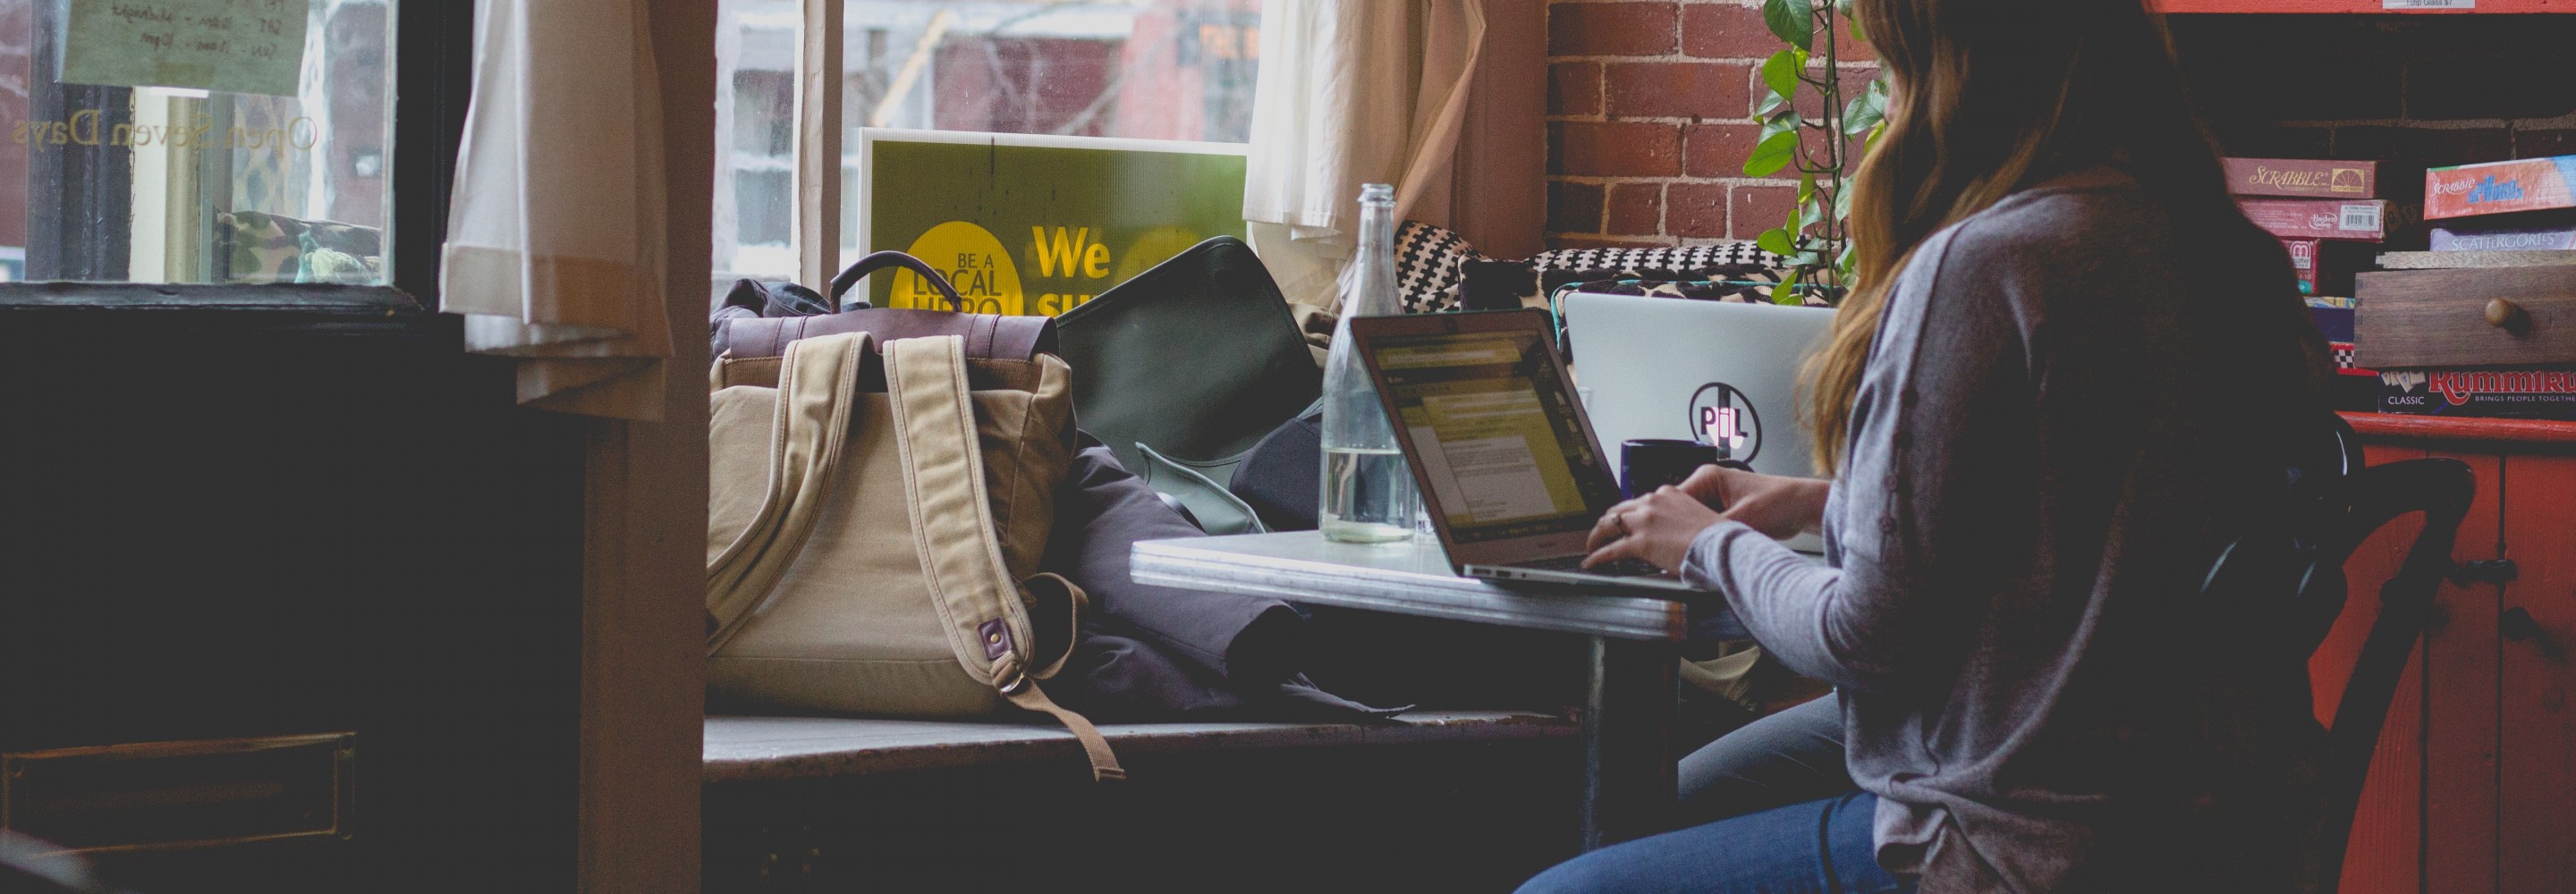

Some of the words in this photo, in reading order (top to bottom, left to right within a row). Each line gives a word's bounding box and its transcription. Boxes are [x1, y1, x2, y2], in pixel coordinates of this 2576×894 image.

[958, 253, 977, 268] BE
[983, 254, 994, 269] A
[1031, 225, 1110, 280] We
[913, 268, 1002, 296] LOCAL
[2387, 396, 2425, 406] CLASSIC
[1700, 406, 1749, 438] PiL
